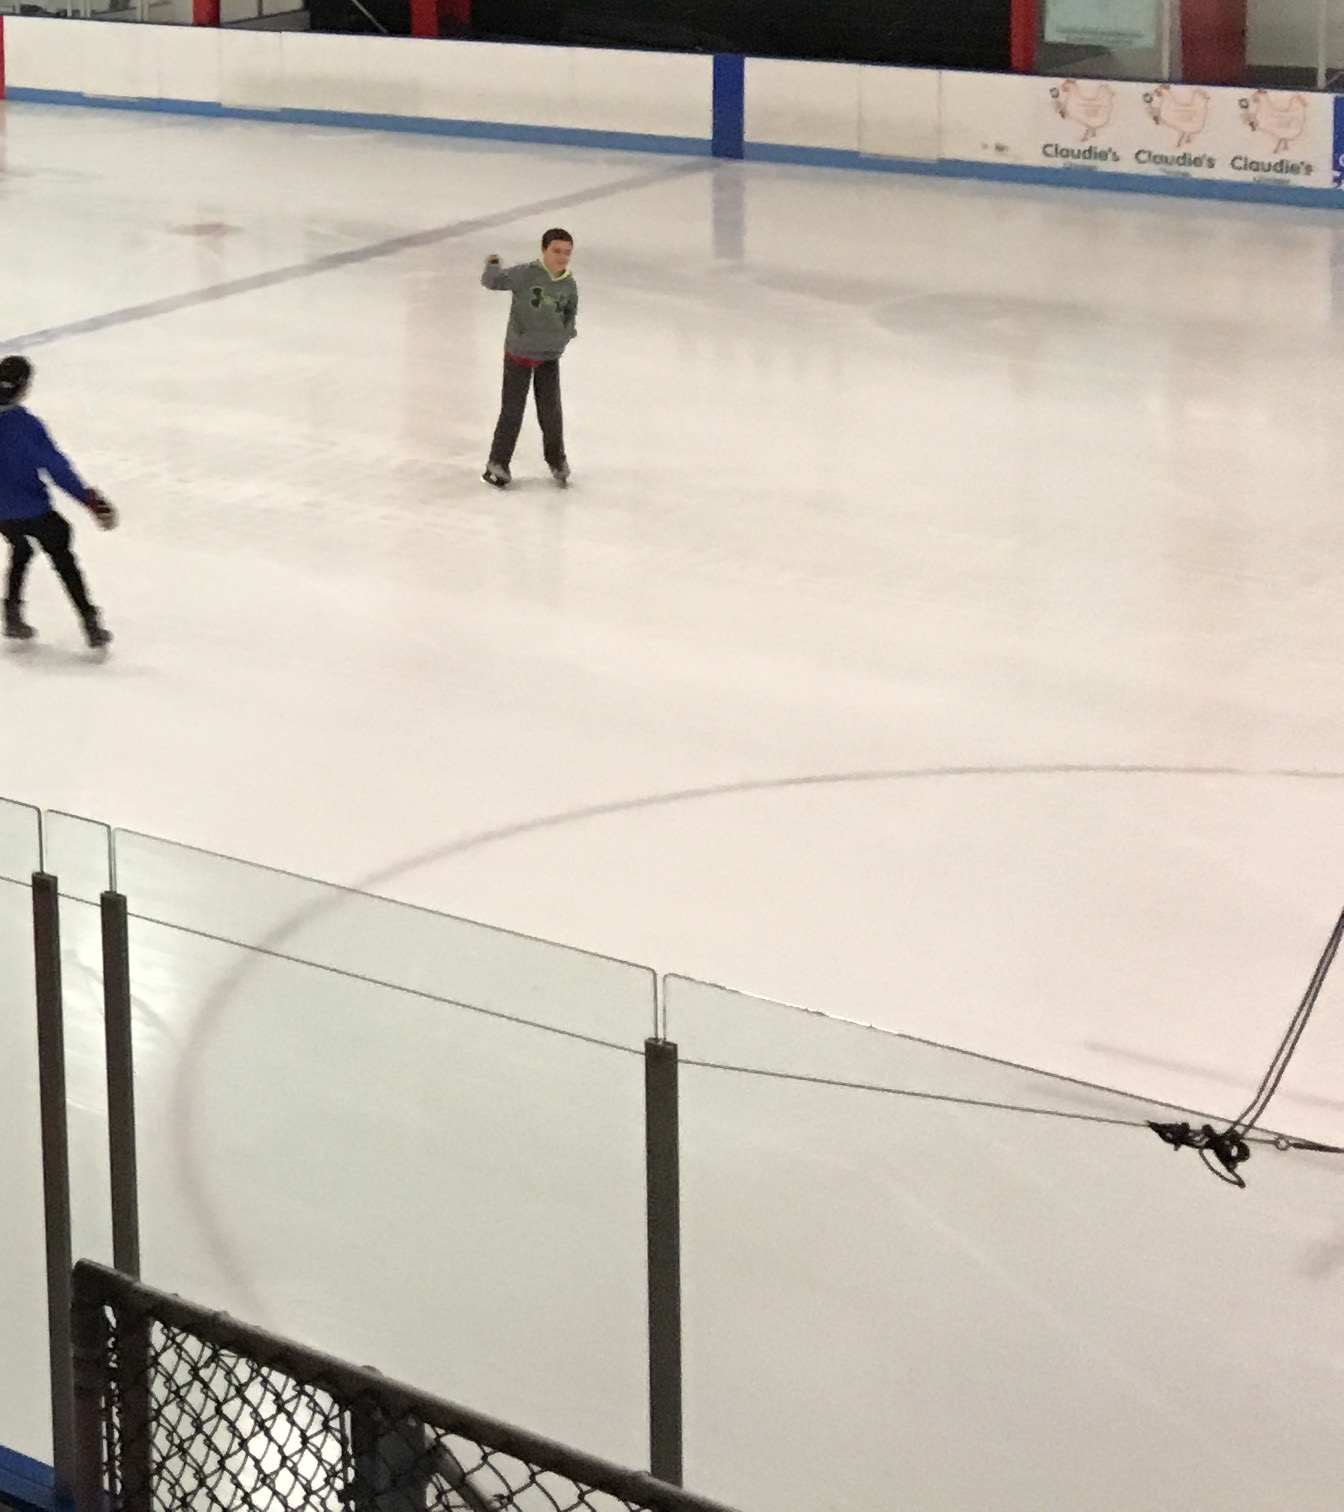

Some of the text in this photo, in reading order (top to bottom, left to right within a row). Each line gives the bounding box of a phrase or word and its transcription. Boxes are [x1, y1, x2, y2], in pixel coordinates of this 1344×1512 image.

[1042, 142, 1120, 163] Claudie's
[1134, 148, 1215, 169] Claudie's
[1230, 154, 1314, 176] Claudie's
